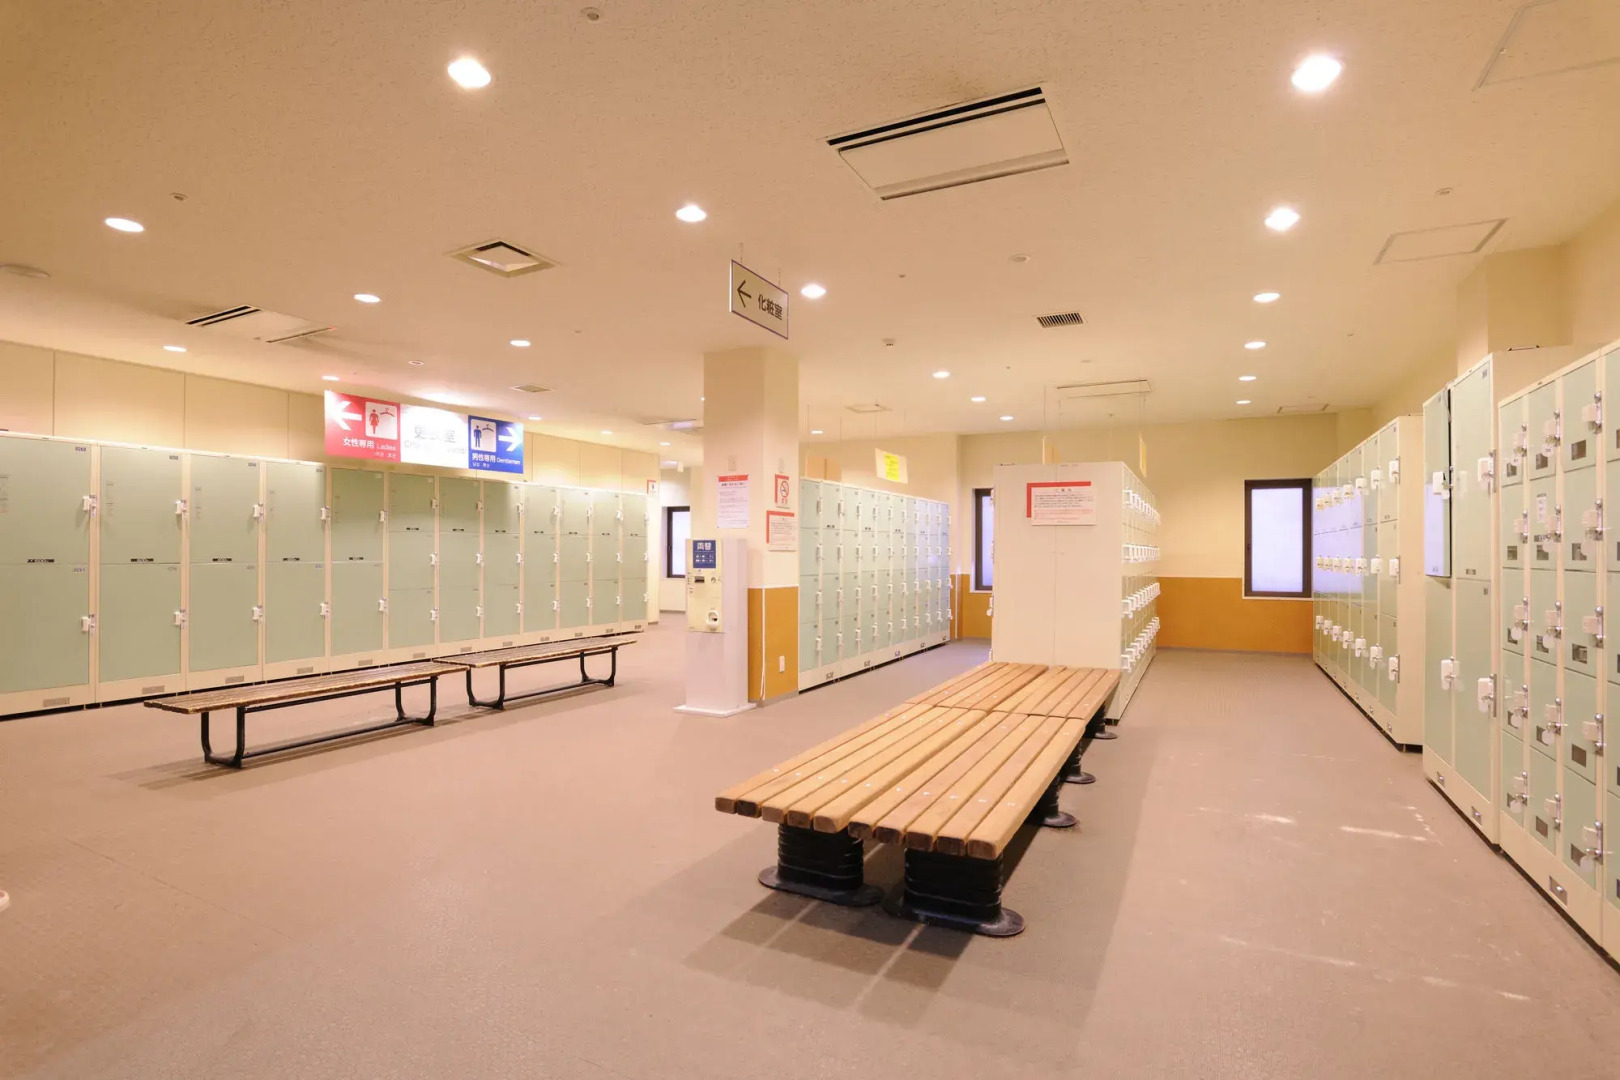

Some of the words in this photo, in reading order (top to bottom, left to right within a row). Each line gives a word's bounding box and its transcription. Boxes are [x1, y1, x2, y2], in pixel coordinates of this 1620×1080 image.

[758, 294, 782, 320] 化粧室
[343, 437, 375, 449] 女性専用
[376, 443, 396, 451] Ladies
[472, 452, 496, 463] 男性専用
